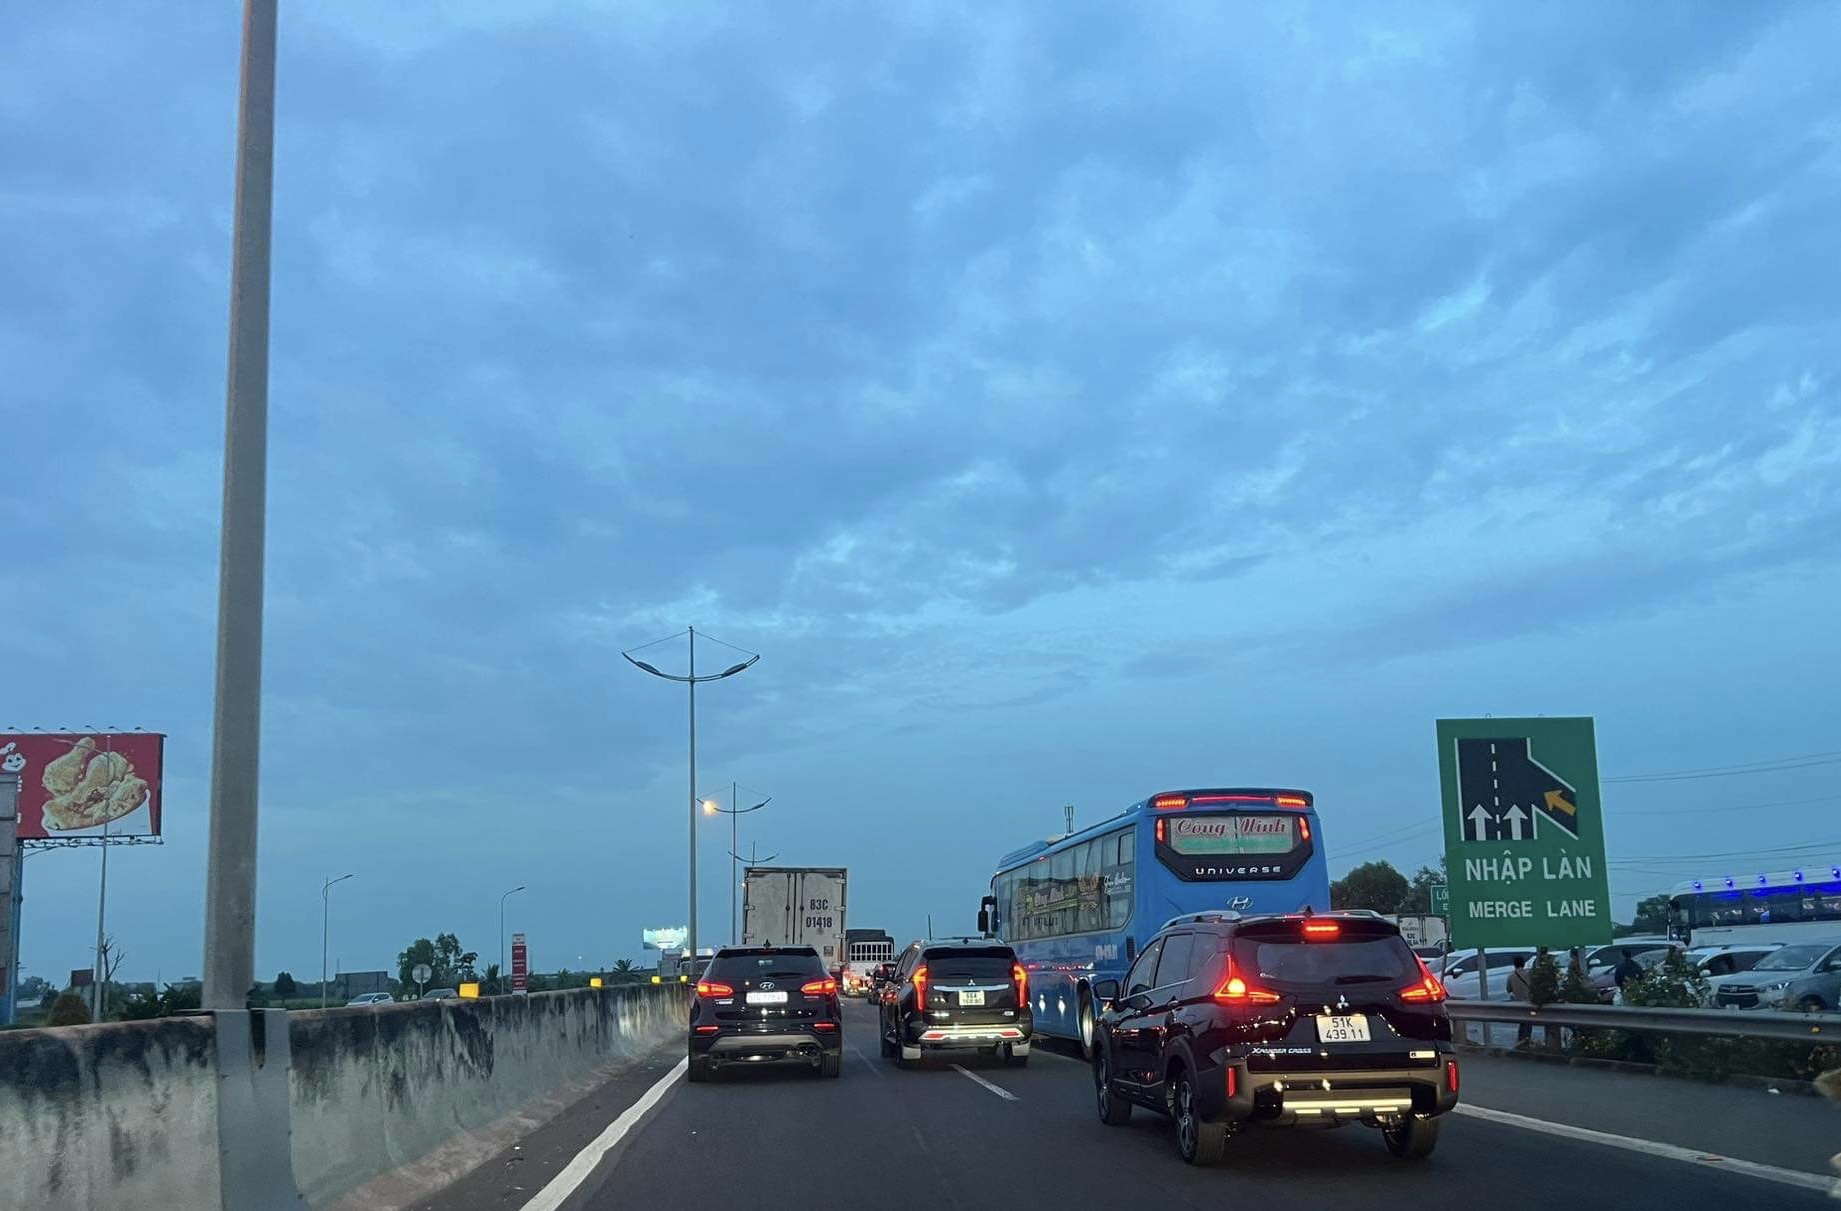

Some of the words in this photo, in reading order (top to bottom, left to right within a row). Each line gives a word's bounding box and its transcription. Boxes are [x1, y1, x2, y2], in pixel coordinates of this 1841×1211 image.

[1195, 866, 1282, 875] UNIVERSE
[1465, 850, 1533, 885] NHẬP
[1543, 848, 1592, 879] LÀN
[810, 899, 828, 911] 83C
[1469, 901, 1533, 918] MERGE
[1547, 900, 1596, 917] LANE
[1331, 1017, 1353, 1028] 51K
